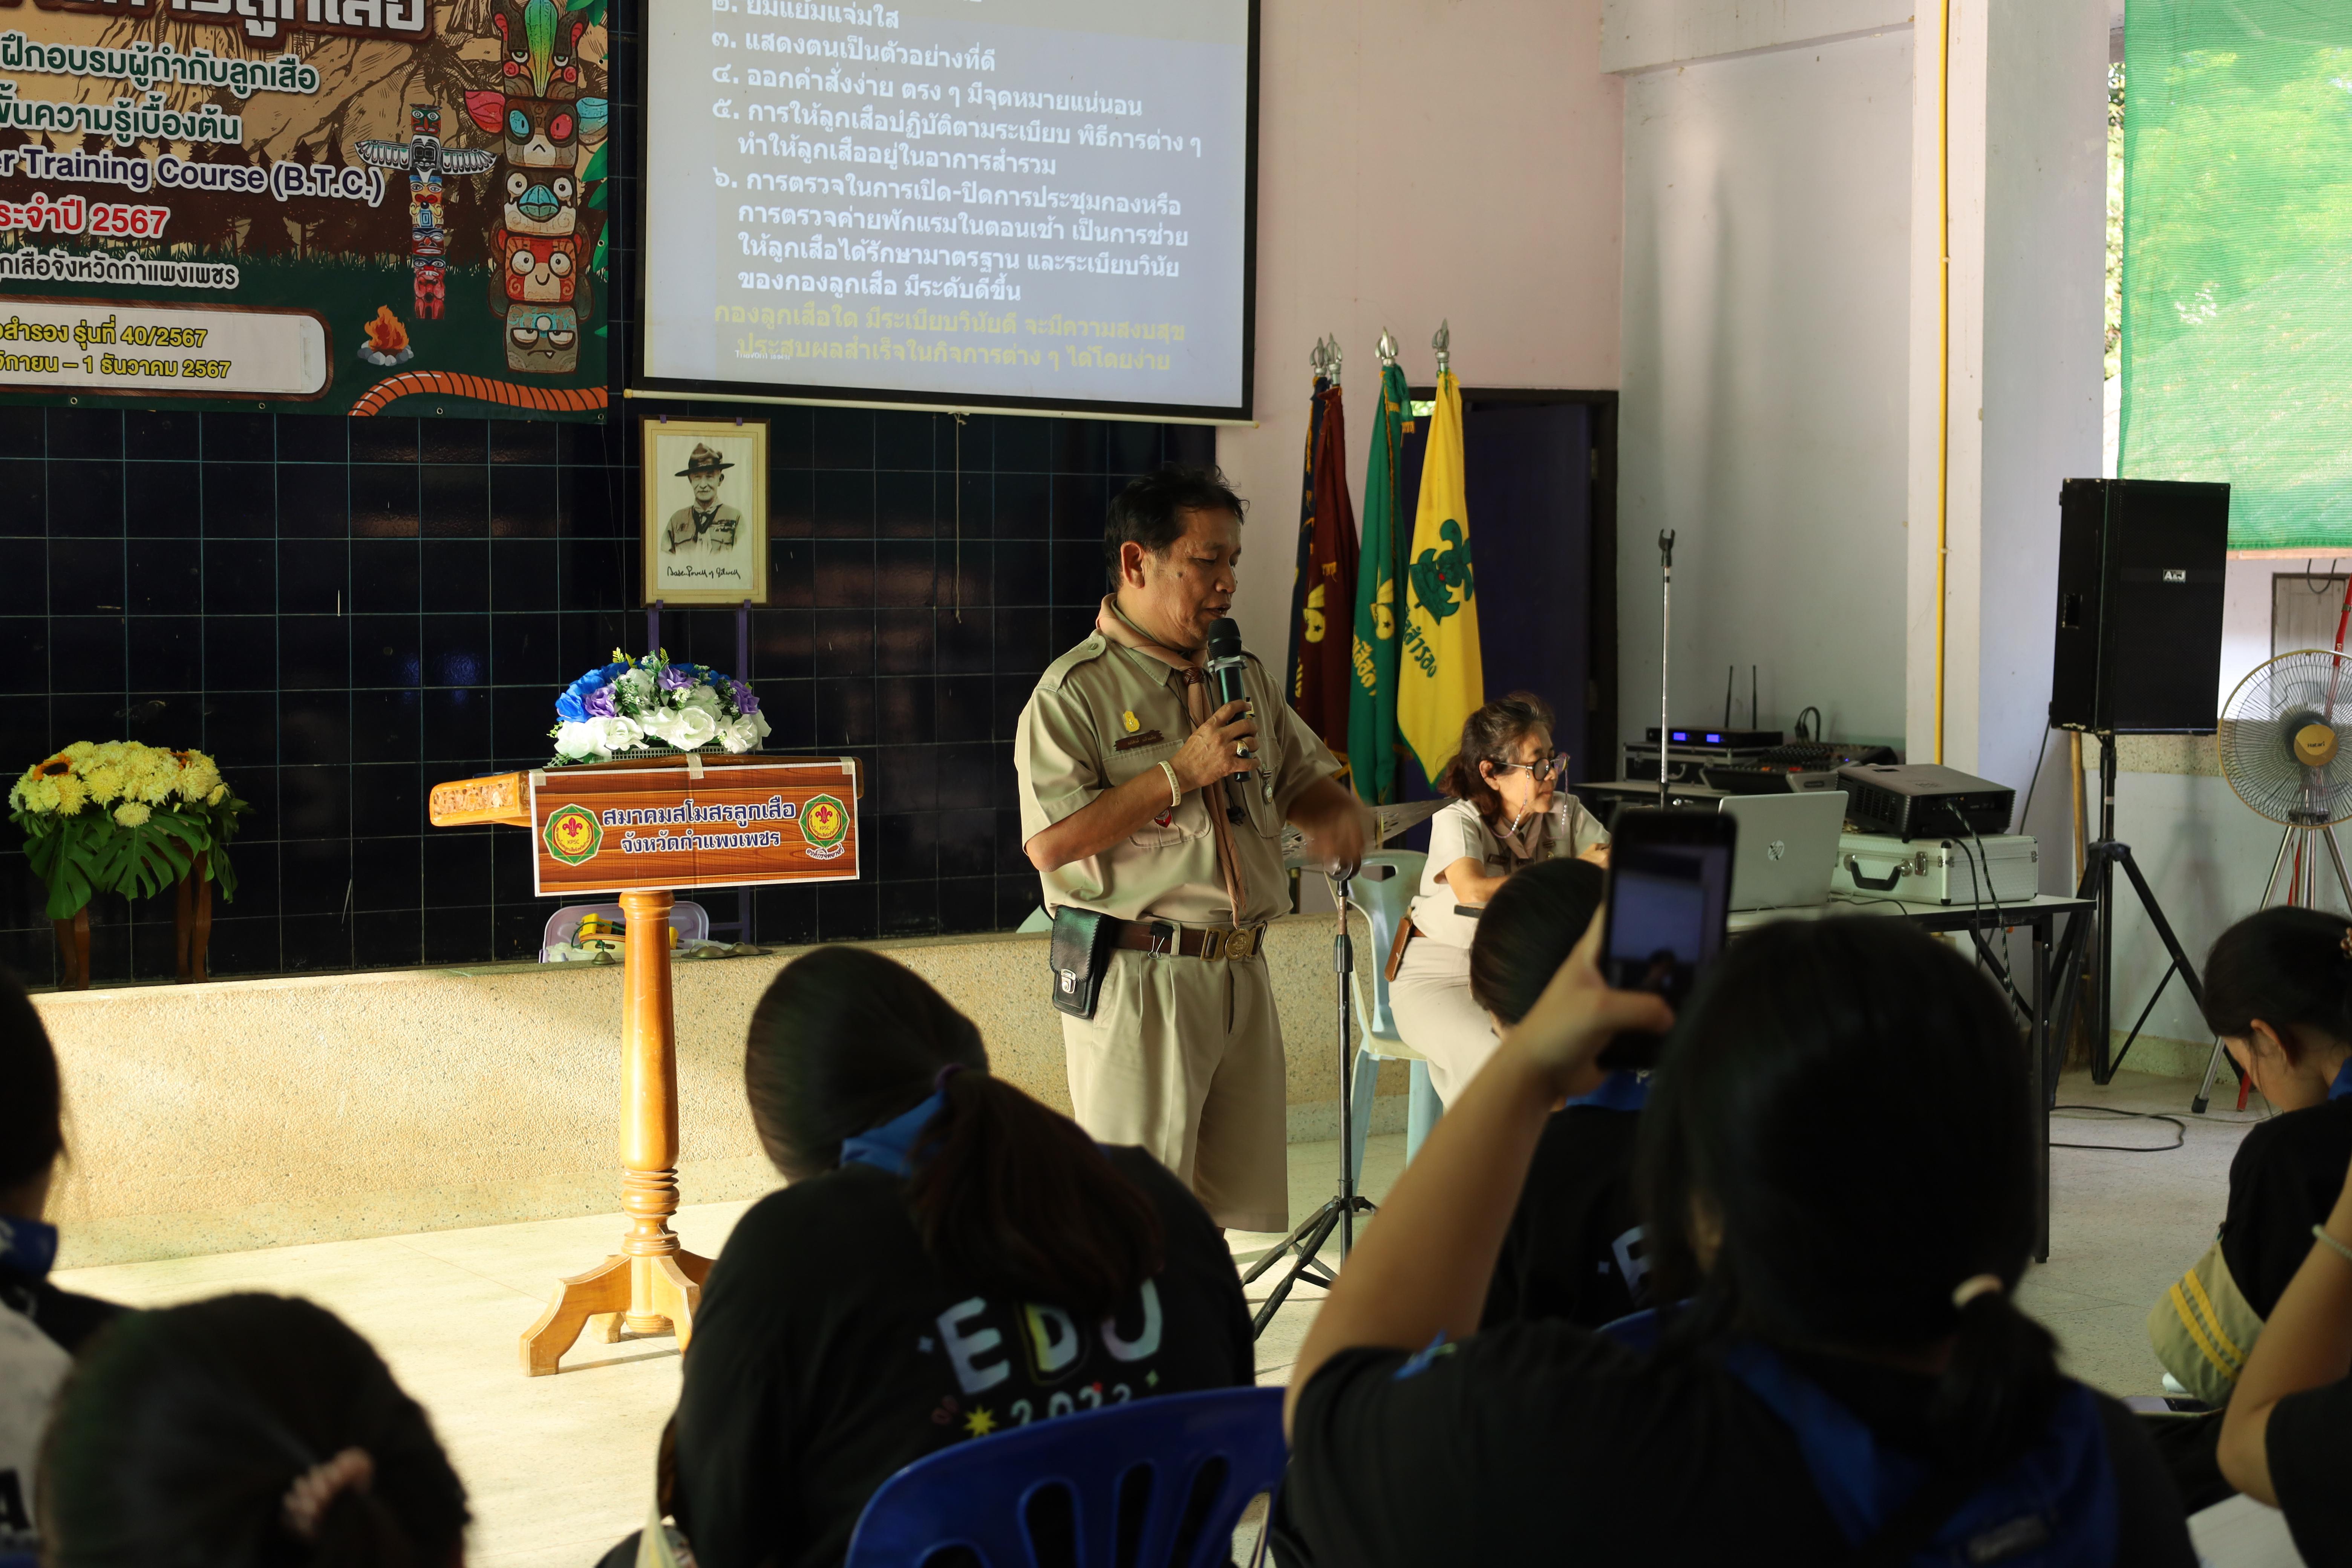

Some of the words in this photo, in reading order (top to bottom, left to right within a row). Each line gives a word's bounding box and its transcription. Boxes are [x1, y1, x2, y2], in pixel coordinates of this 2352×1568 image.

[746, 32, 996, 71] แสดงตนเป็นตัวอย่างที่ดี
[747, 62, 893, 98] ออกคำสั่งง่าย
[902, 83, 941, 101] ตรง
[968, 82, 1142, 116] มีจุดหมายแน่นอน
[749, 100, 1070, 144] การให้ลูกเสือปฏิบัติตามระเบียบ
[1078, 122, 1183, 152] พิธีการต่าง
[738, 131, 1056, 175] ทำให้ลูกเสืออยู่ในอาการสำรวม
[23, 149, 148, 187] Training
[158, 158, 264, 186] Course
[274, 164, 382, 203] (B.T.C.)
[747, 172, 1181, 215] การตรวจในการเปิด-ปิดการประชุมกองหรือ
[93, 206, 167, 235] 2567
[739, 205, 1064, 240] การตรวจค่ายพักแรมในตอนเช้า
[1072, 217, 1188, 247] เป็นการช่วย
[738, 232, 1020, 273] ให้ลูกเสือได้รักษามาตรฐาน
[1027, 252, 1179, 277] และระเบียบวินัย
[738, 270, 897, 298] ของกองลูกเสือ
[905, 273, 1021, 301] มีระดับดีขึ้น
[73, 314, 116, 351] รุ่นที่
[120, 326, 208, 348] 40/2567
[714, 301, 858, 329] กองลูกเสือใด
[865, 305, 1017, 335] มีระเบียบวินัยดี
[83, 355, 93, 374] 1
[100, 353, 178, 377] ธันวาคม
[182, 360, 231, 378] 2567
[1066, 346, 1170, 370] ได้โดยง่าย
[604, 795, 795, 827] สมาคมสโมสรลูกเสือ
[622, 829, 779, 853] จังหวัดกำแพงเพชร
